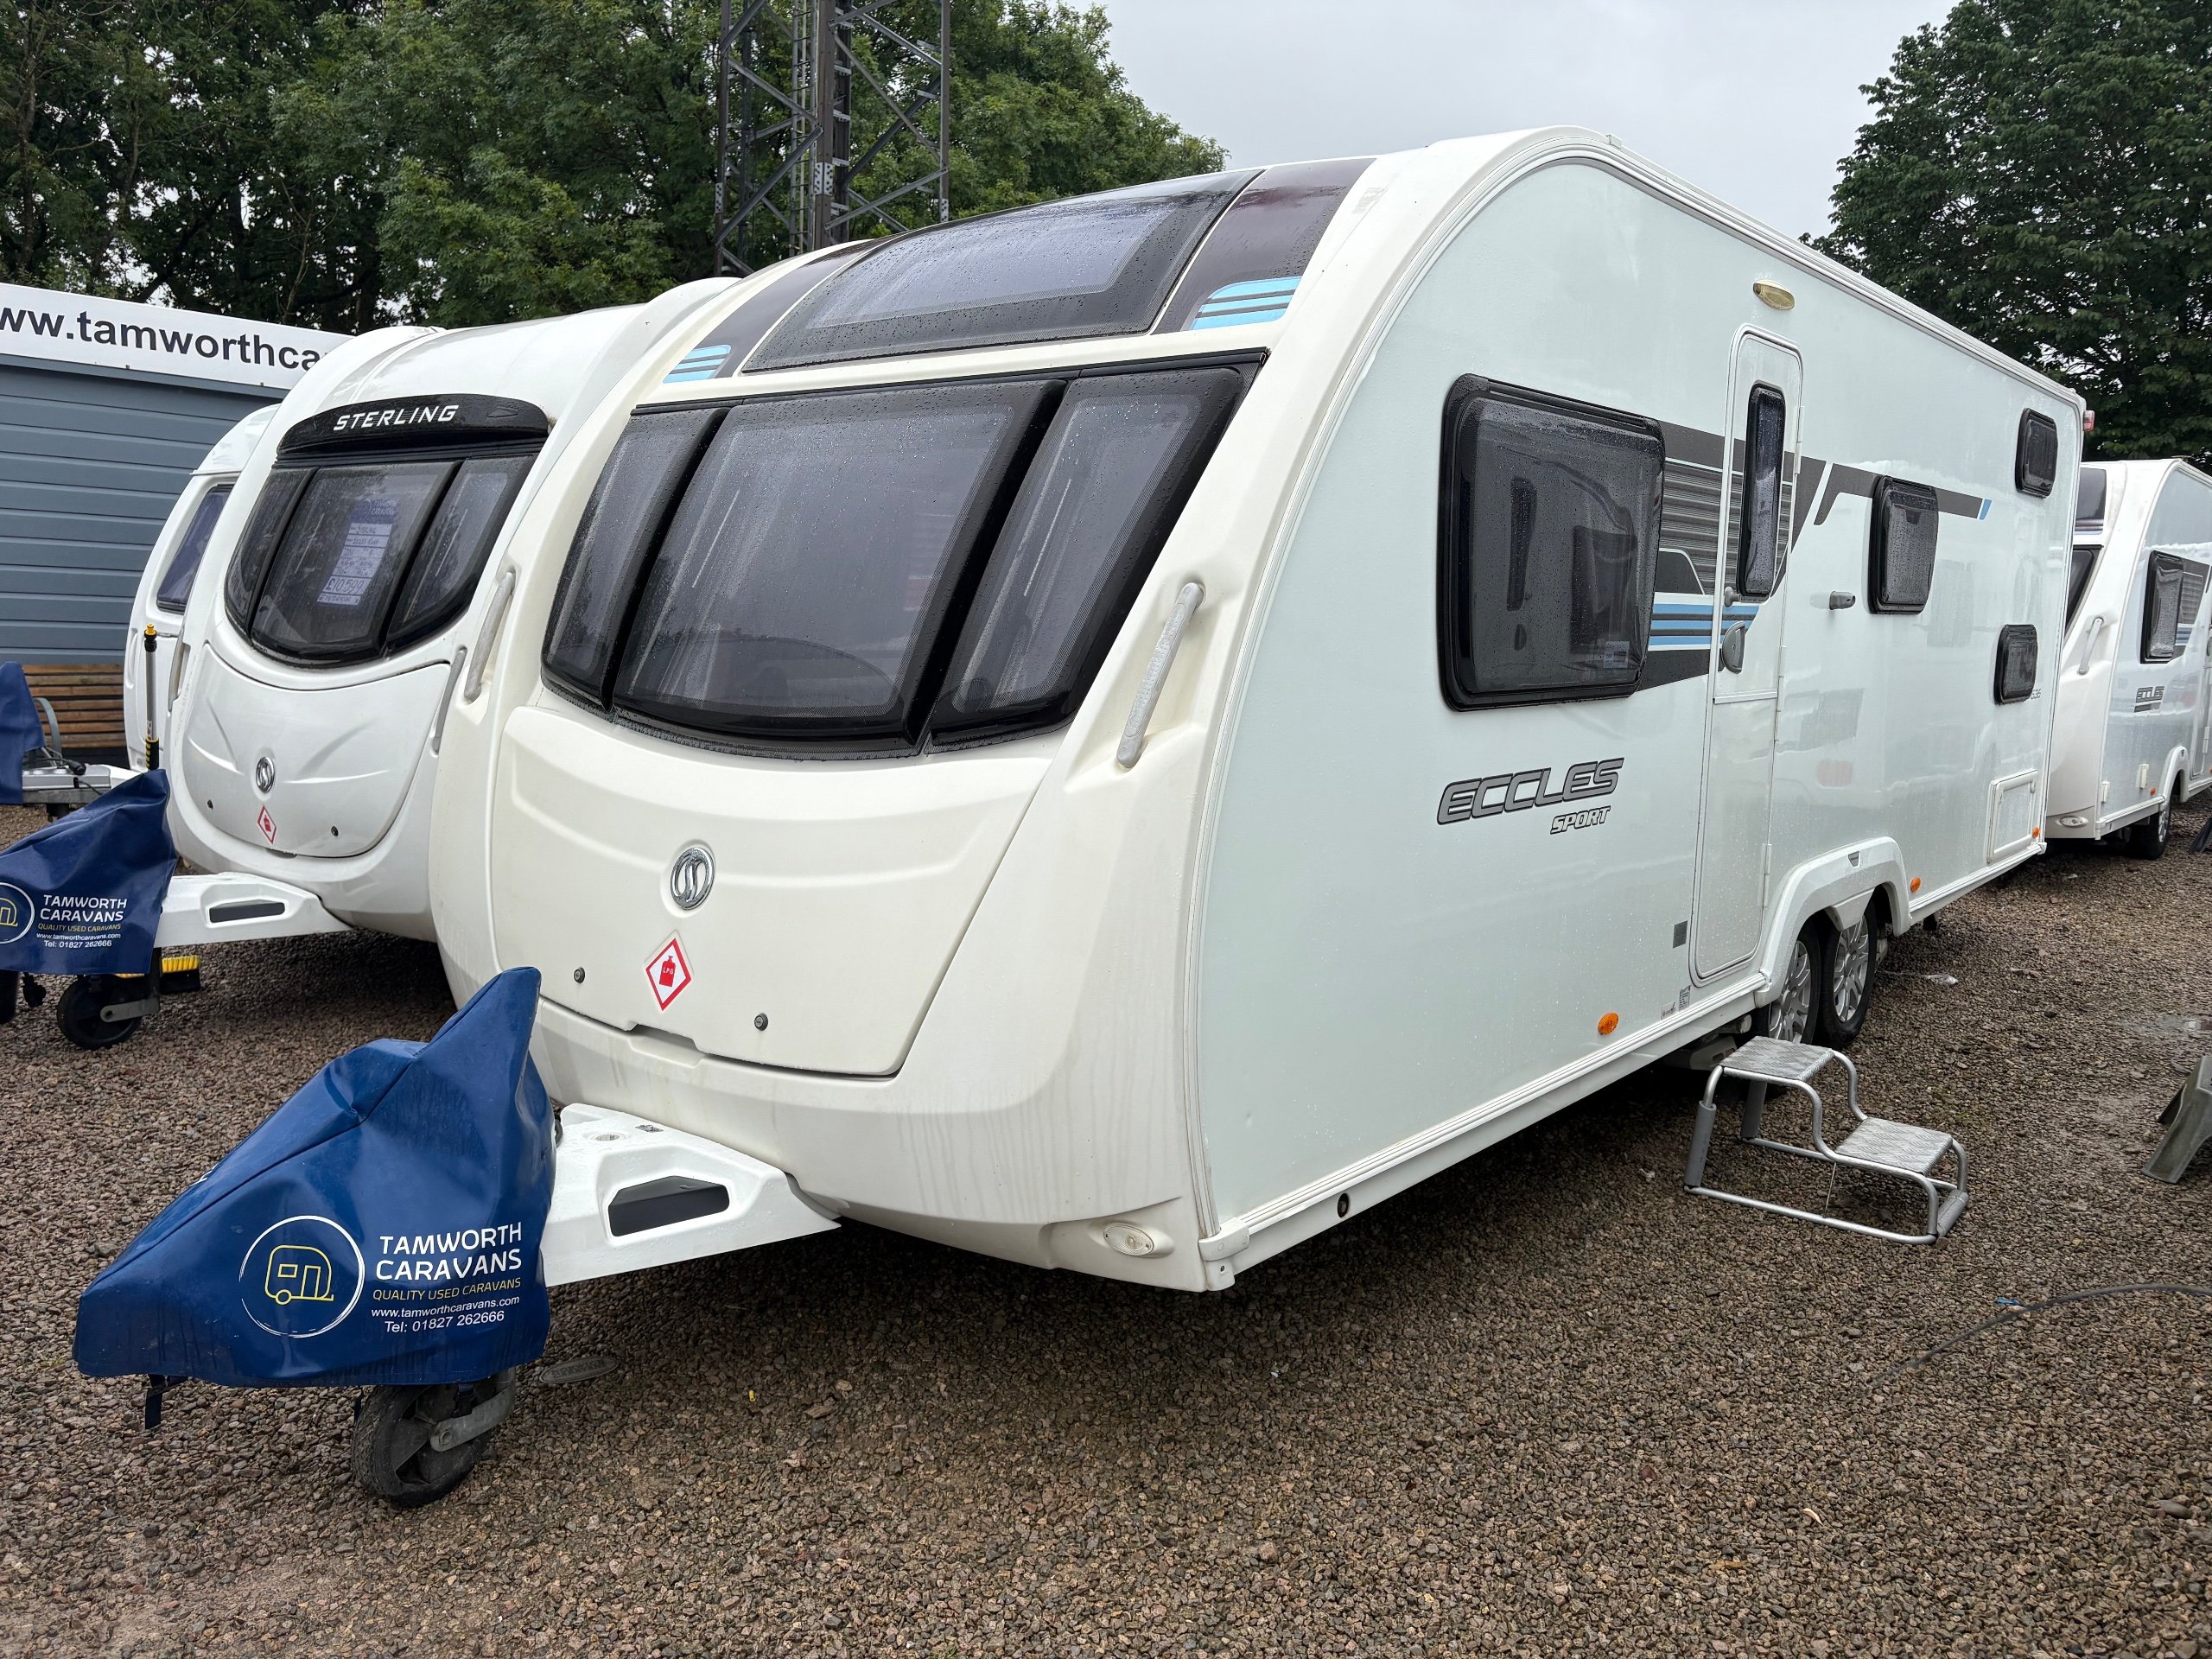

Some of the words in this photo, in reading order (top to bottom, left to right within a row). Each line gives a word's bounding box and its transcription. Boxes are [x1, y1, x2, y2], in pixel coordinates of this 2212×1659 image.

[0, 307, 327, 372] ww.tamworthca
[333, 404, 460, 431] STERLING
[1437, 757, 1624, 825] ECCLES
[1550, 805, 1611, 835] SPORT
[43, 894, 128, 909] TAMWORTH
[40, 908, 124, 923] CARAVANS
[87, 924, 122, 932] CARAVANS
[379, 1222, 522, 1255] TAMWORTH
[376, 1249, 522, 1281] CARAVANS
[372, 1289, 426, 1301] QUALITY
[428, 1288, 460, 1300] USED
[462, 1278, 521, 1295] CARAVANS
[371, 1296, 520, 1318] www.tamworthcaravans.com
[384, 1321, 408, 1333] Tel:
[412, 1316, 454, 1332] 01827
[456, 1311, 505, 1326] 262666
